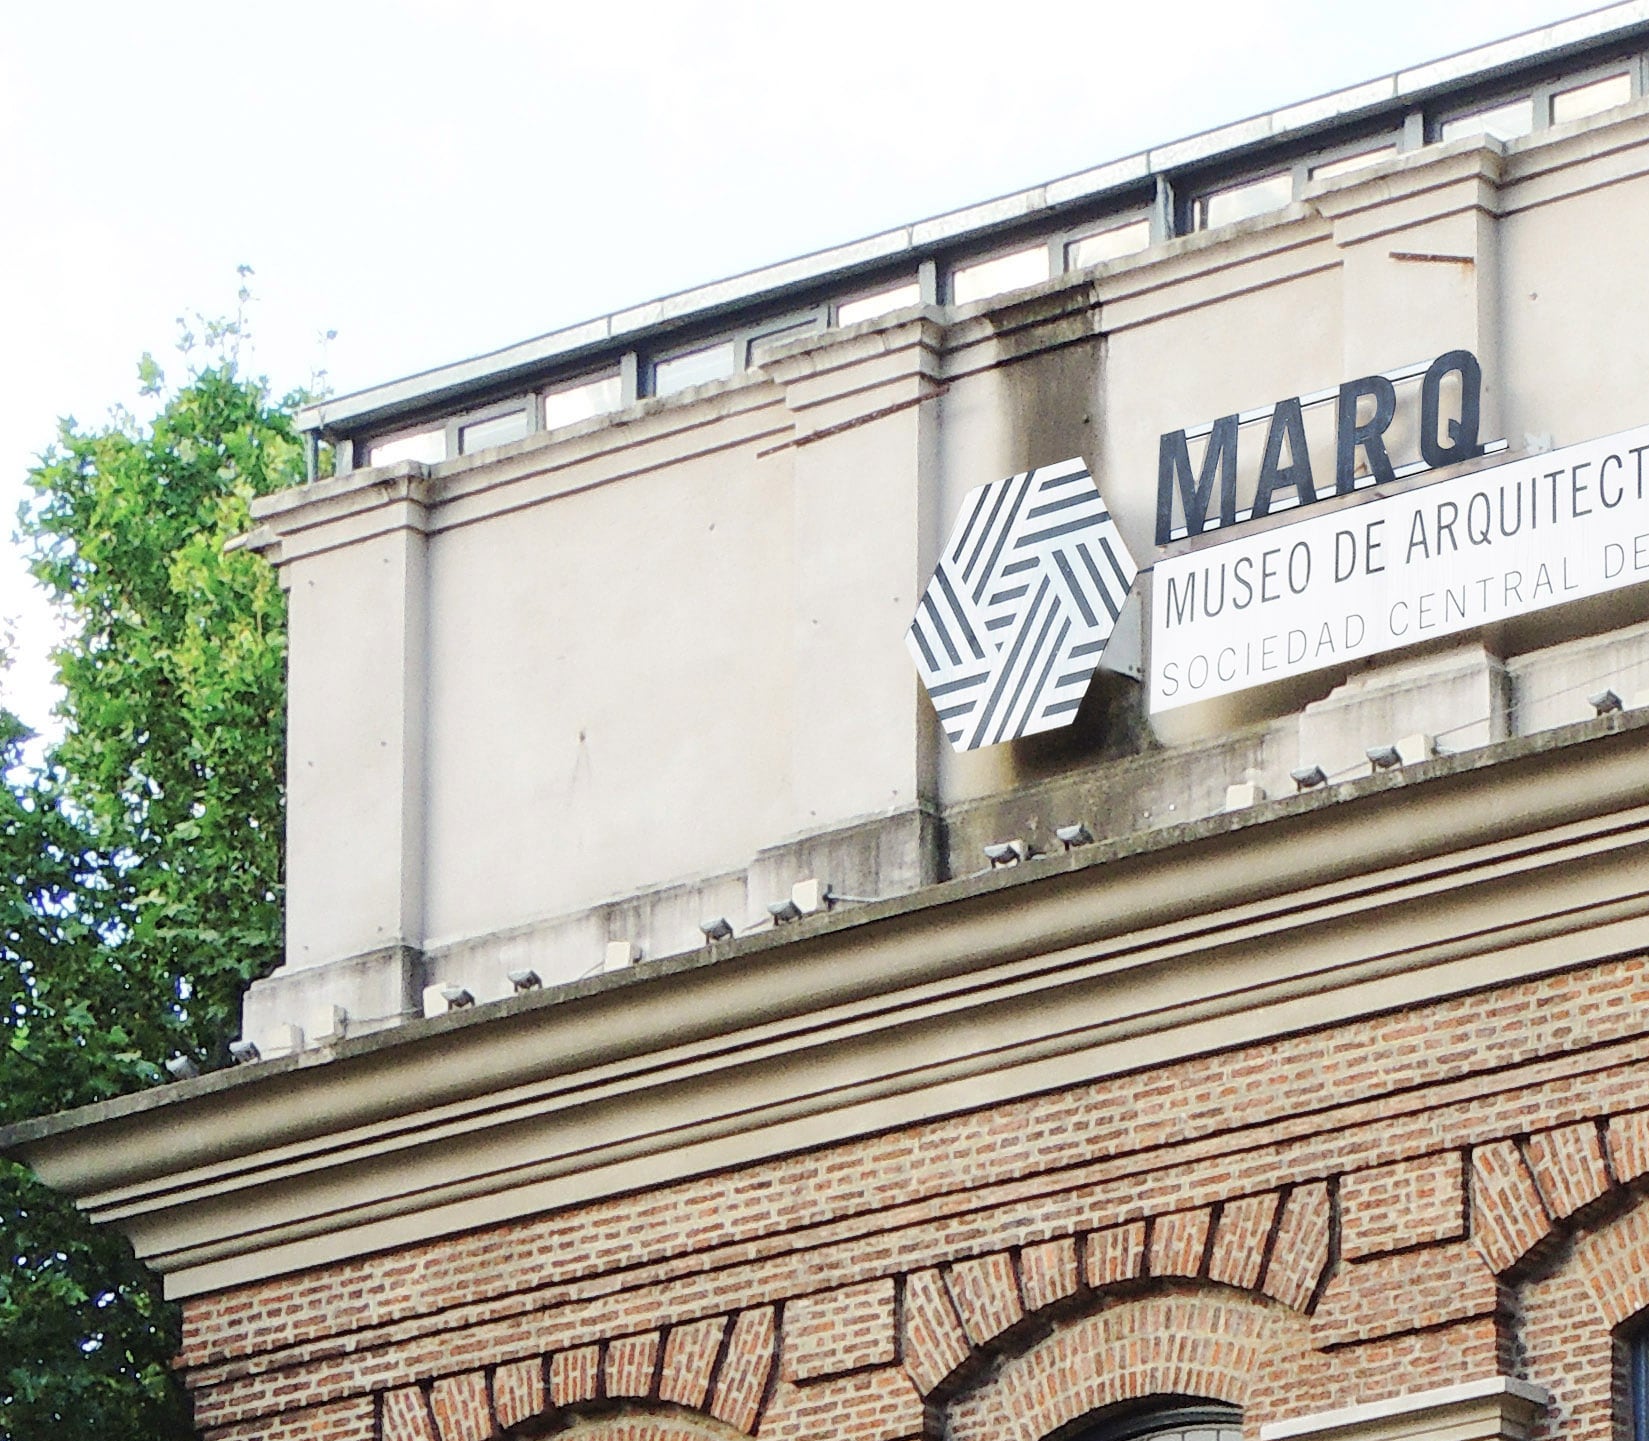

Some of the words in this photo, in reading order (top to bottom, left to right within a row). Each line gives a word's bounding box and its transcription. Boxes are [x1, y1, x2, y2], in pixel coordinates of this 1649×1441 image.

[1155, 349, 1485, 545] MARQ
[1161, 614, 1365, 697] SOCIEDAD
[1389, 556, 1578, 636] CENTRAL
[1166, 541, 1311, 629] MUSEO
[1335, 519, 1386, 583] DE
